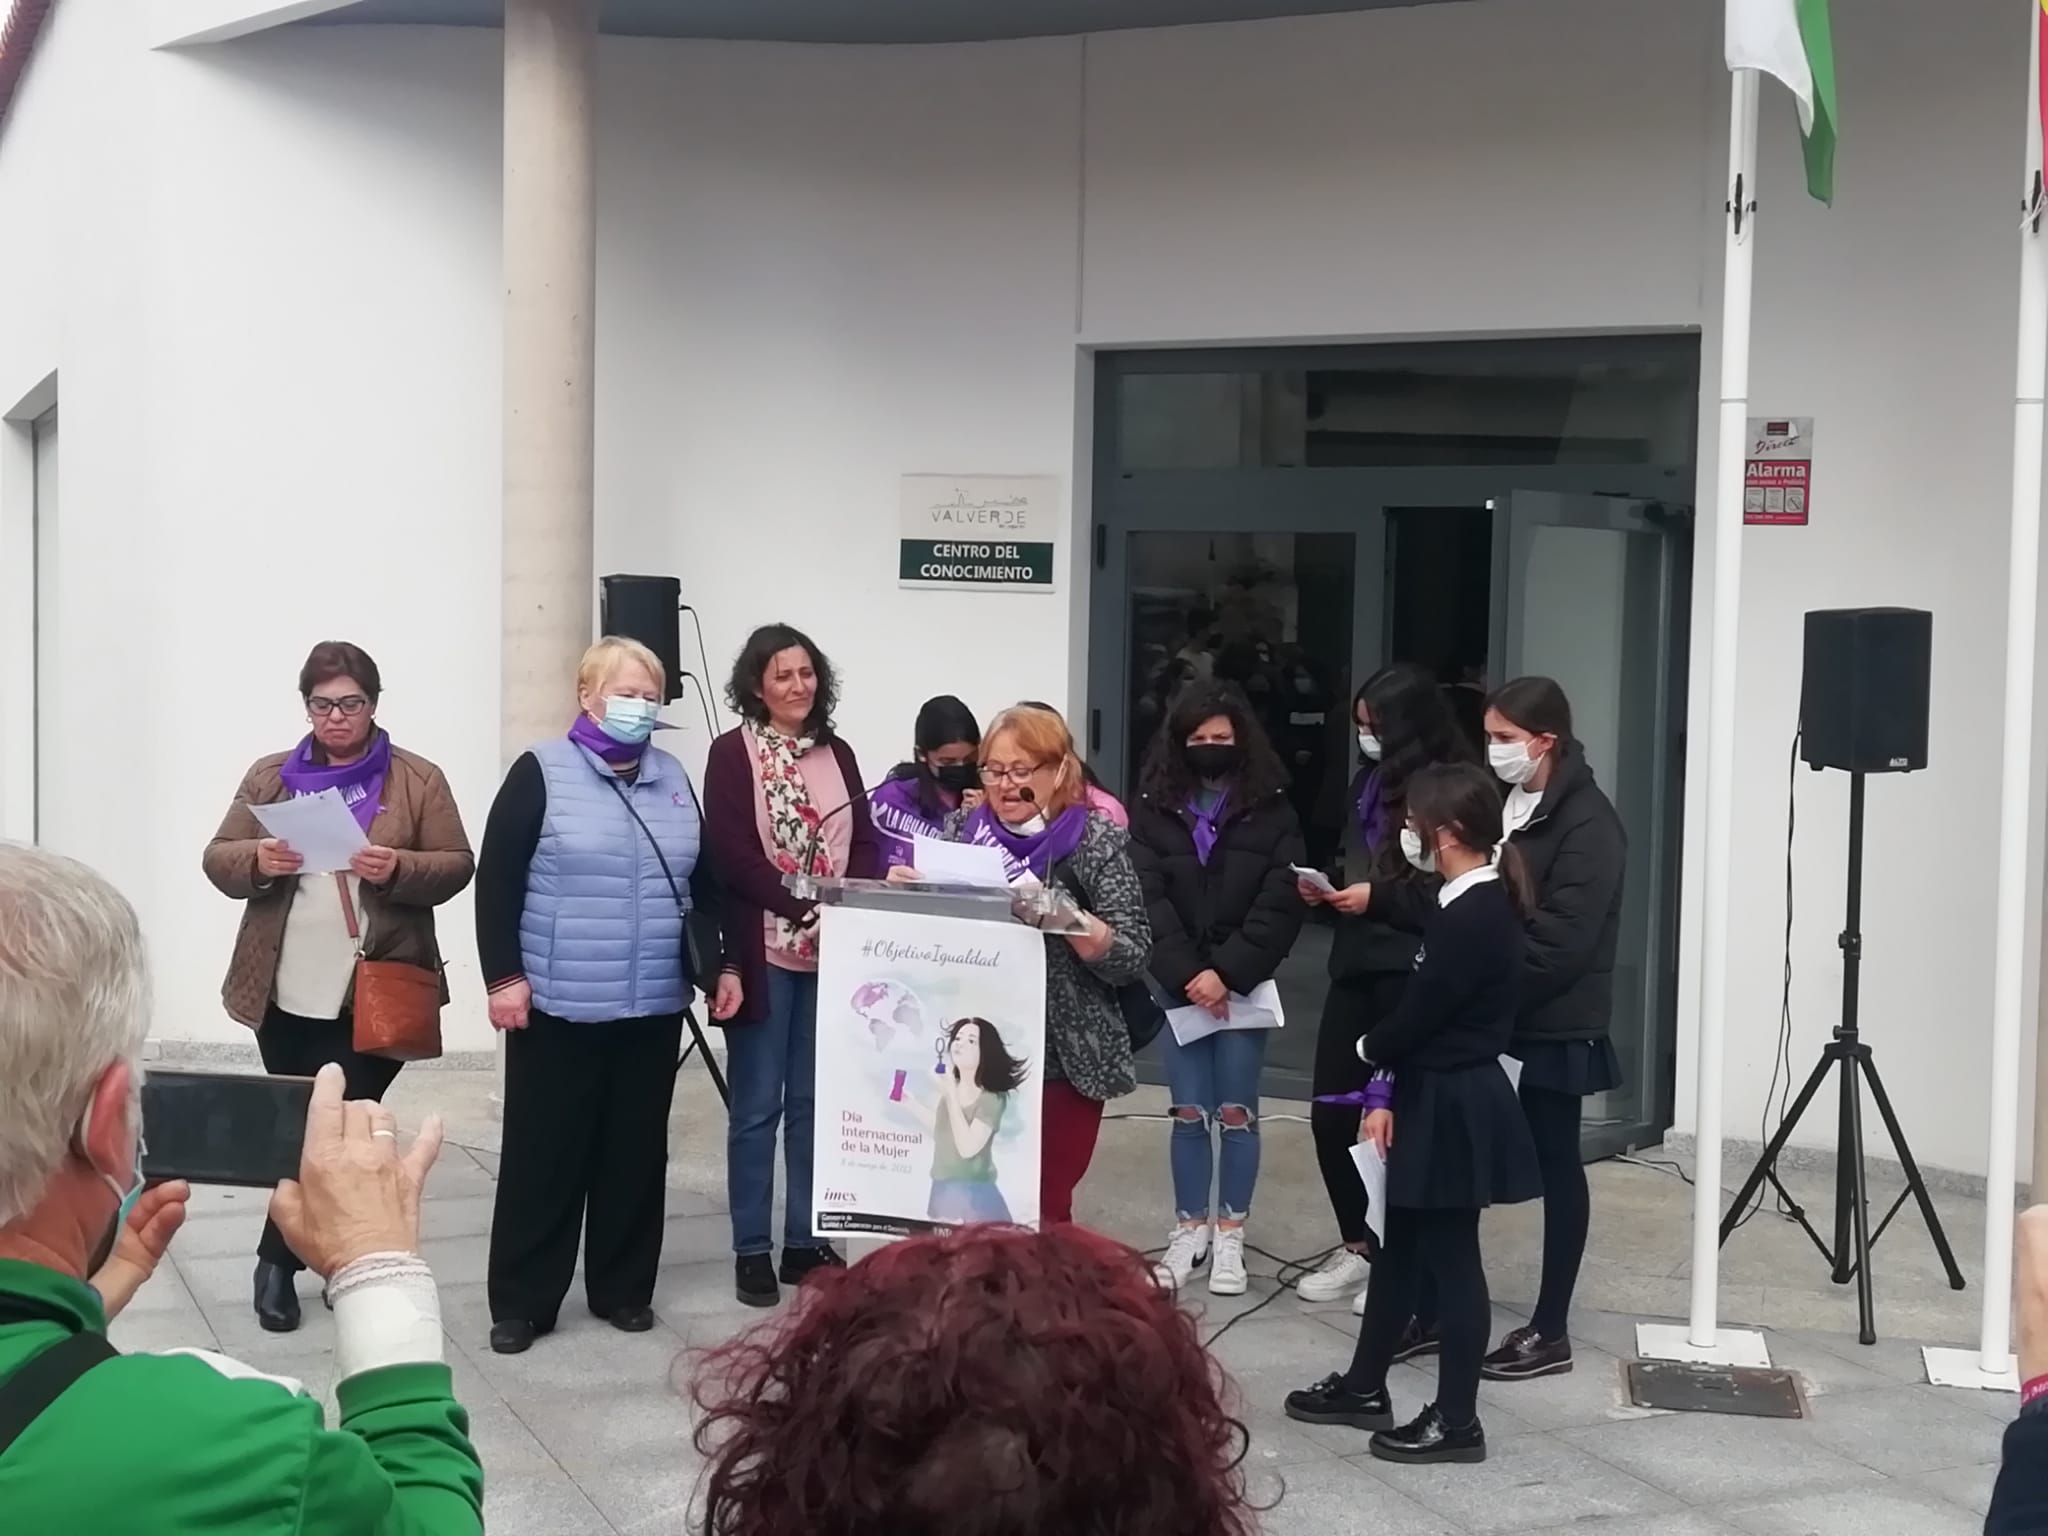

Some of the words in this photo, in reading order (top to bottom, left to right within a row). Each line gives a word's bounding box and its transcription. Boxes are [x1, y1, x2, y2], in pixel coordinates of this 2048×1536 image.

[1746, 462, 1806, 477] Alarma
[931, 510, 1026, 524] VALVERDE
[933, 543, 990, 559] CENTRO
[995, 545, 1020, 559] DEL
[920, 563, 1033, 580] CONOCIMIENTO
[885, 807, 900, 830] LA
[841, 1125, 923, 1145] Internacional
[841, 1140, 856, 1152] de
[860, 1141, 870, 1153] la
[873, 1143, 910, 1159] Mujer
